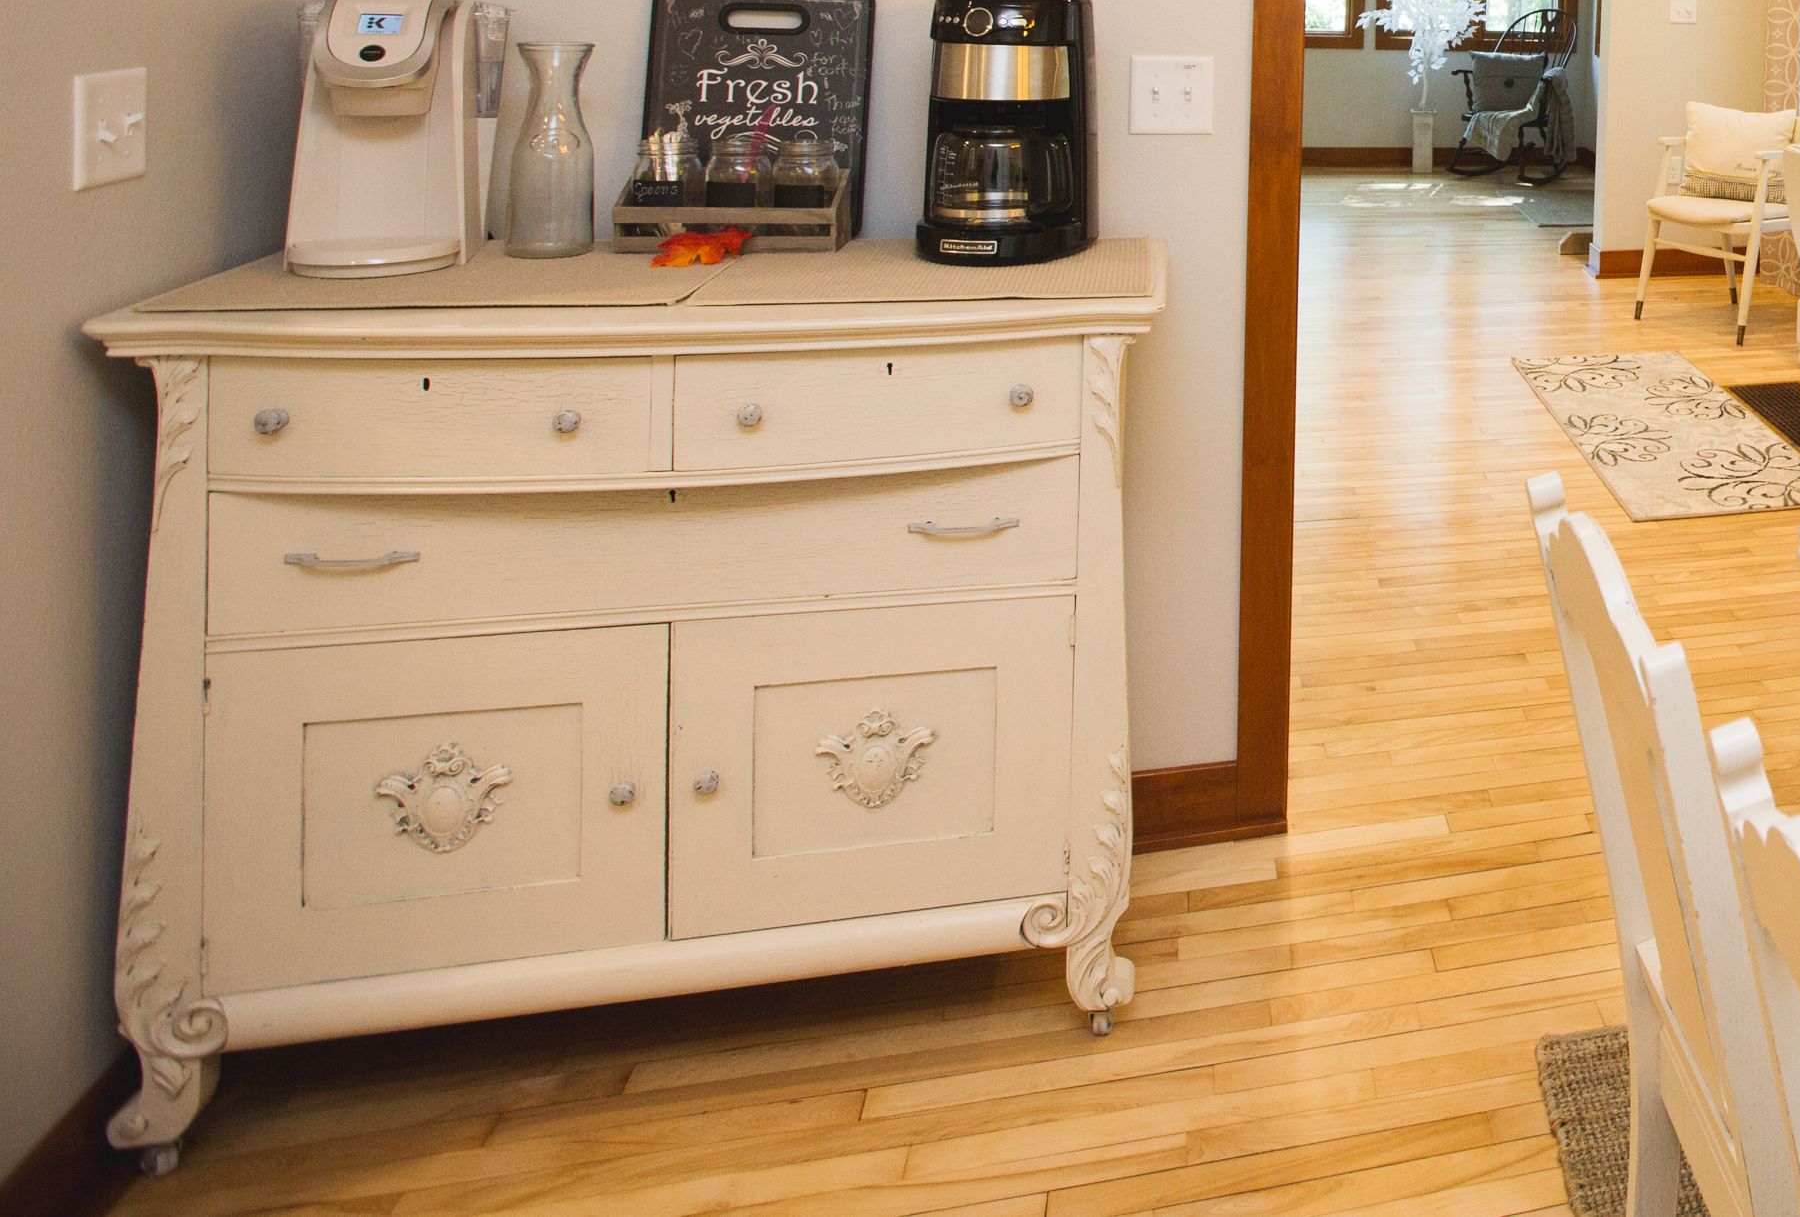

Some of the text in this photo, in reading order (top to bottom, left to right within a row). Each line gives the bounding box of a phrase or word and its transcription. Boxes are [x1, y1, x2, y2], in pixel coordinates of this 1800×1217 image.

[696, 67, 819, 108] Fresh
[694, 105, 820, 140] vegetbles
[943, 243, 993, 251] KitchenAid
